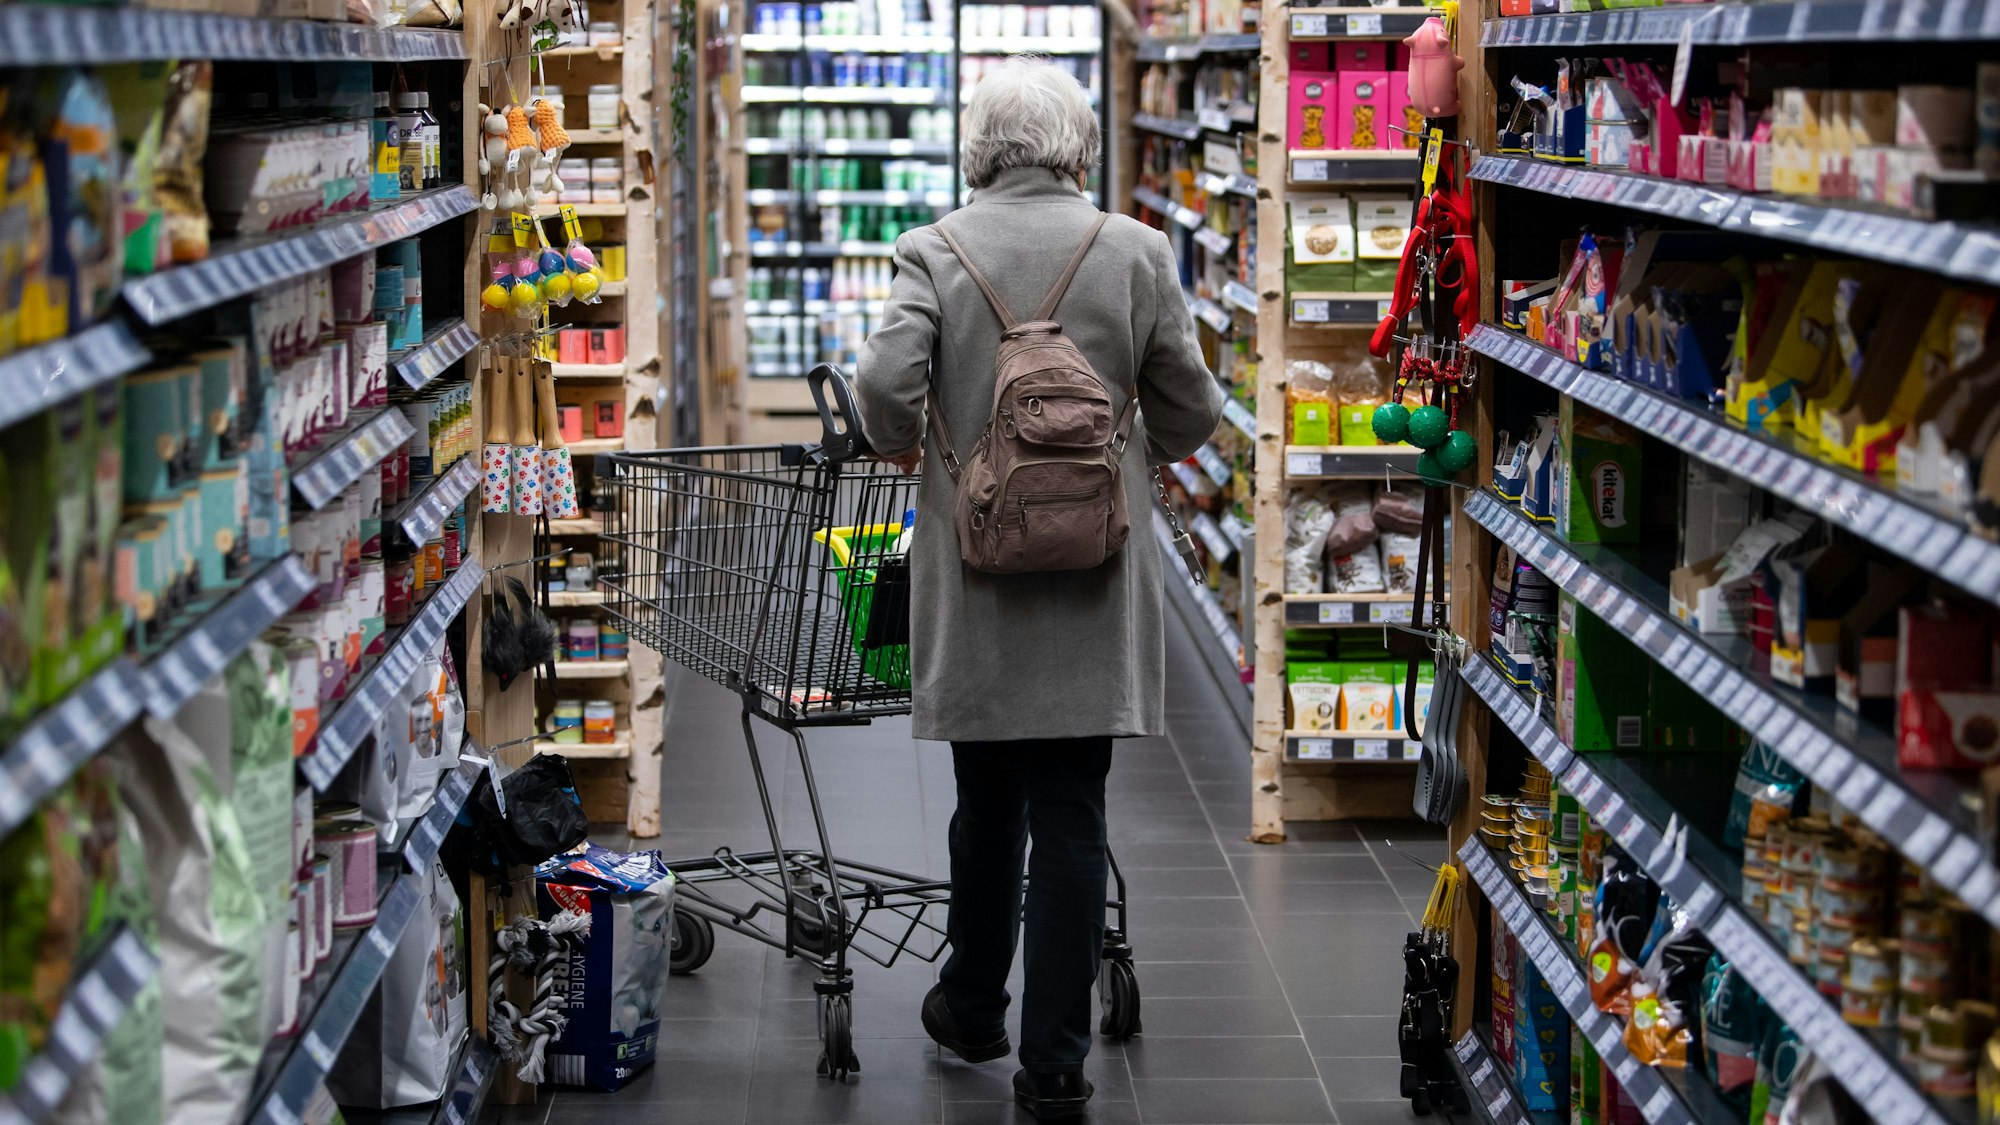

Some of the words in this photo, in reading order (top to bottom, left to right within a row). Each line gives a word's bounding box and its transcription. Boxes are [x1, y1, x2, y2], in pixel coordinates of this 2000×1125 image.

[1602, 468, 1618, 520] kitekat
[554, 886, 585, 917] GÜNSTI
[570, 950, 586, 1010] HYGIENE
[614, 1068, 624, 1079] 20
